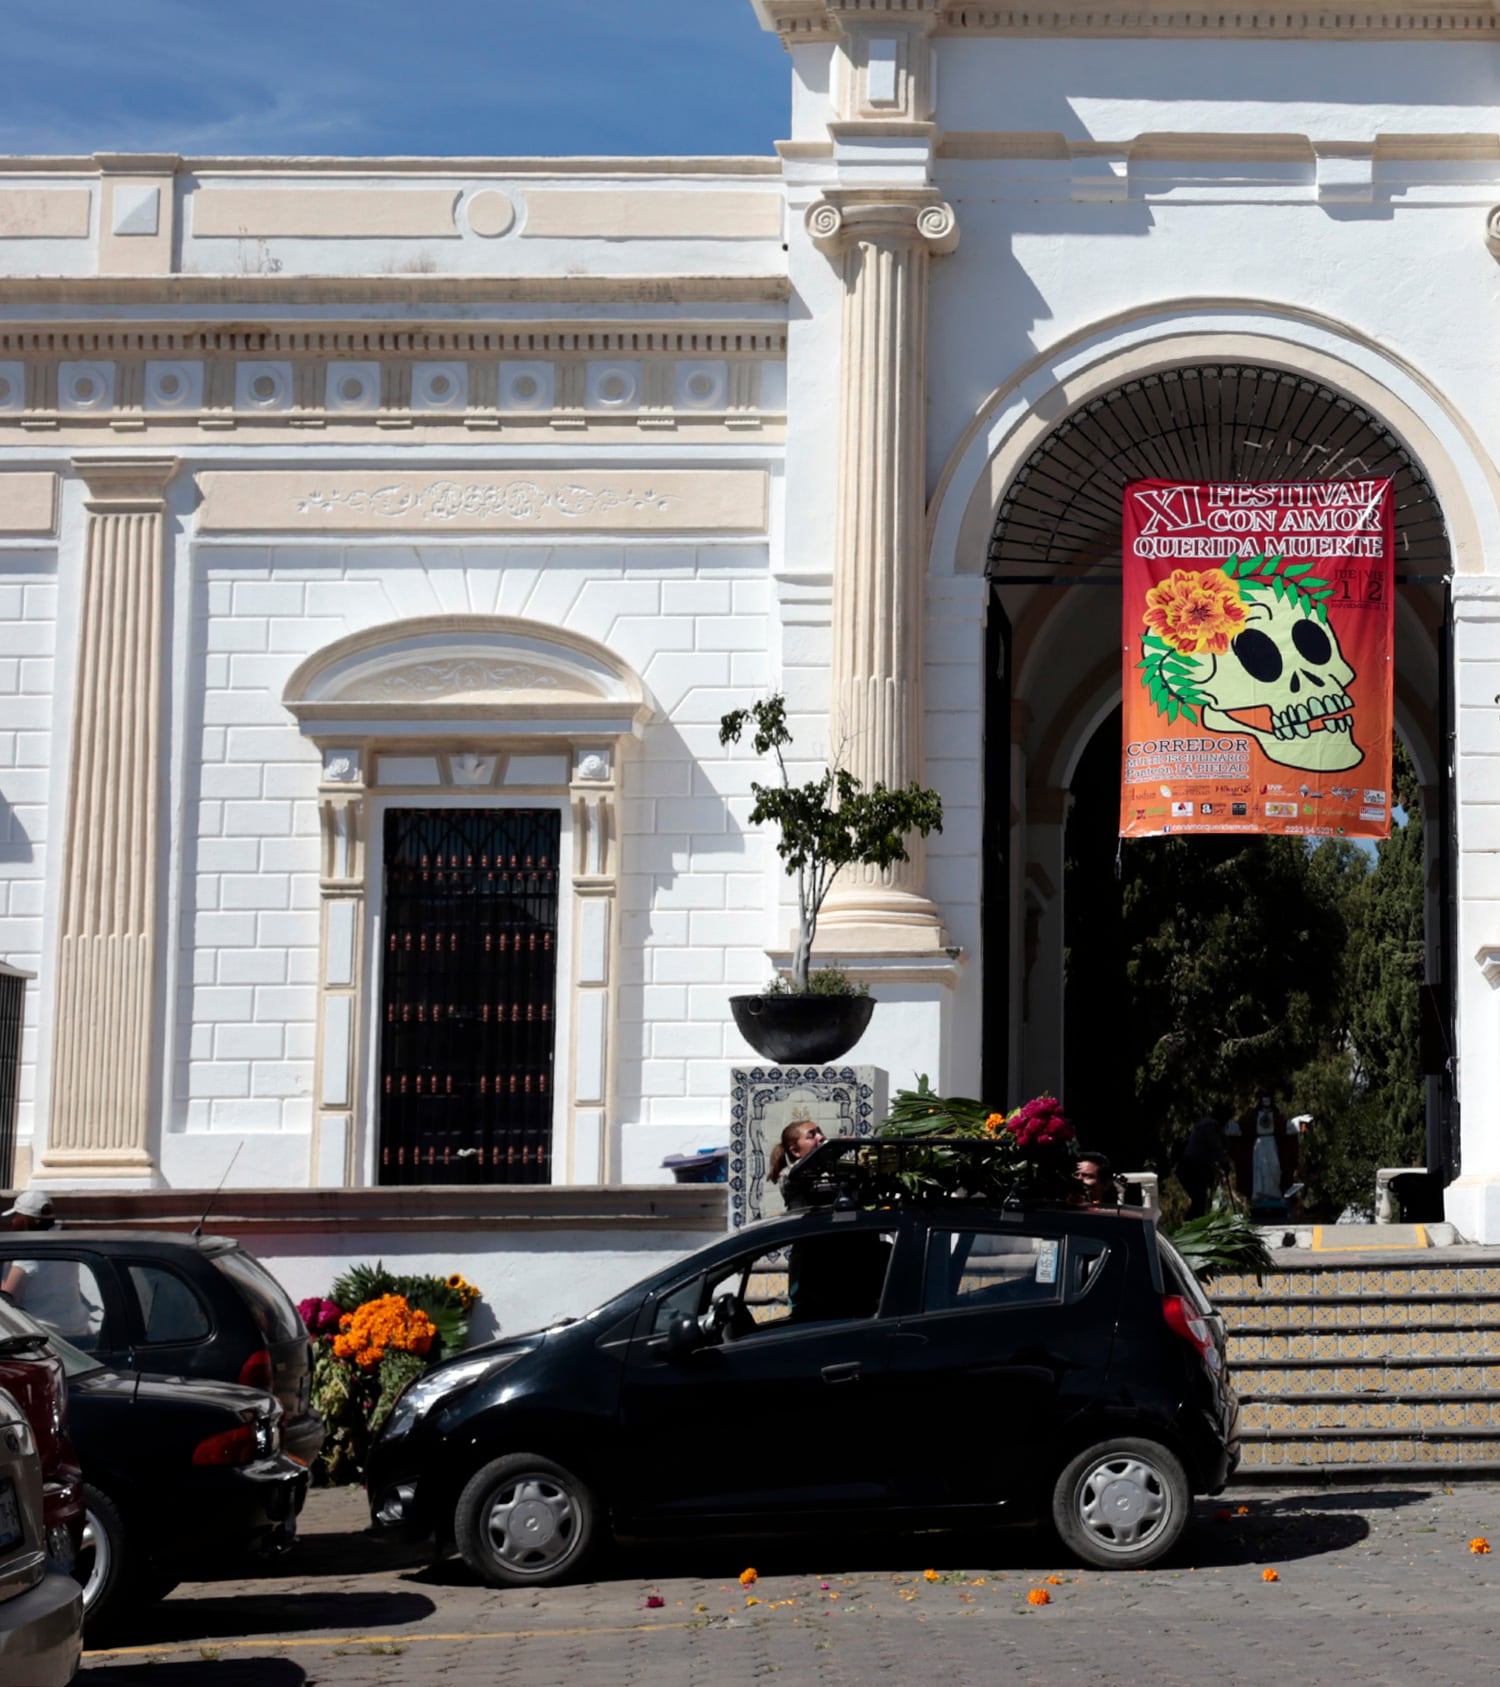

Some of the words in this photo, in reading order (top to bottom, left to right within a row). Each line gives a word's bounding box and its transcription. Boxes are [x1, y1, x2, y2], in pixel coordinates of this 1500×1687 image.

[1207, 481, 1384, 507] FESTIVAL
[1133, 486, 1207, 535] XI
[1206, 510, 1276, 532] CON
[1279, 508, 1384, 532] AMOR
[1133, 537, 1259, 557] QUERIDA
[1264, 537, 1384, 558] MUERTE
[1334, 569, 1357, 580] JUE
[1341, 580, 1351, 599] 1
[1367, 580, 1382, 601] 2
[1126, 739, 1250, 757] CORREDOR
[1126, 753, 1249, 767] MULTIDISCIPLINARIO
[1176, 764, 1194, 774] LA
[1197, 764, 1249, 774] PIEDAD
